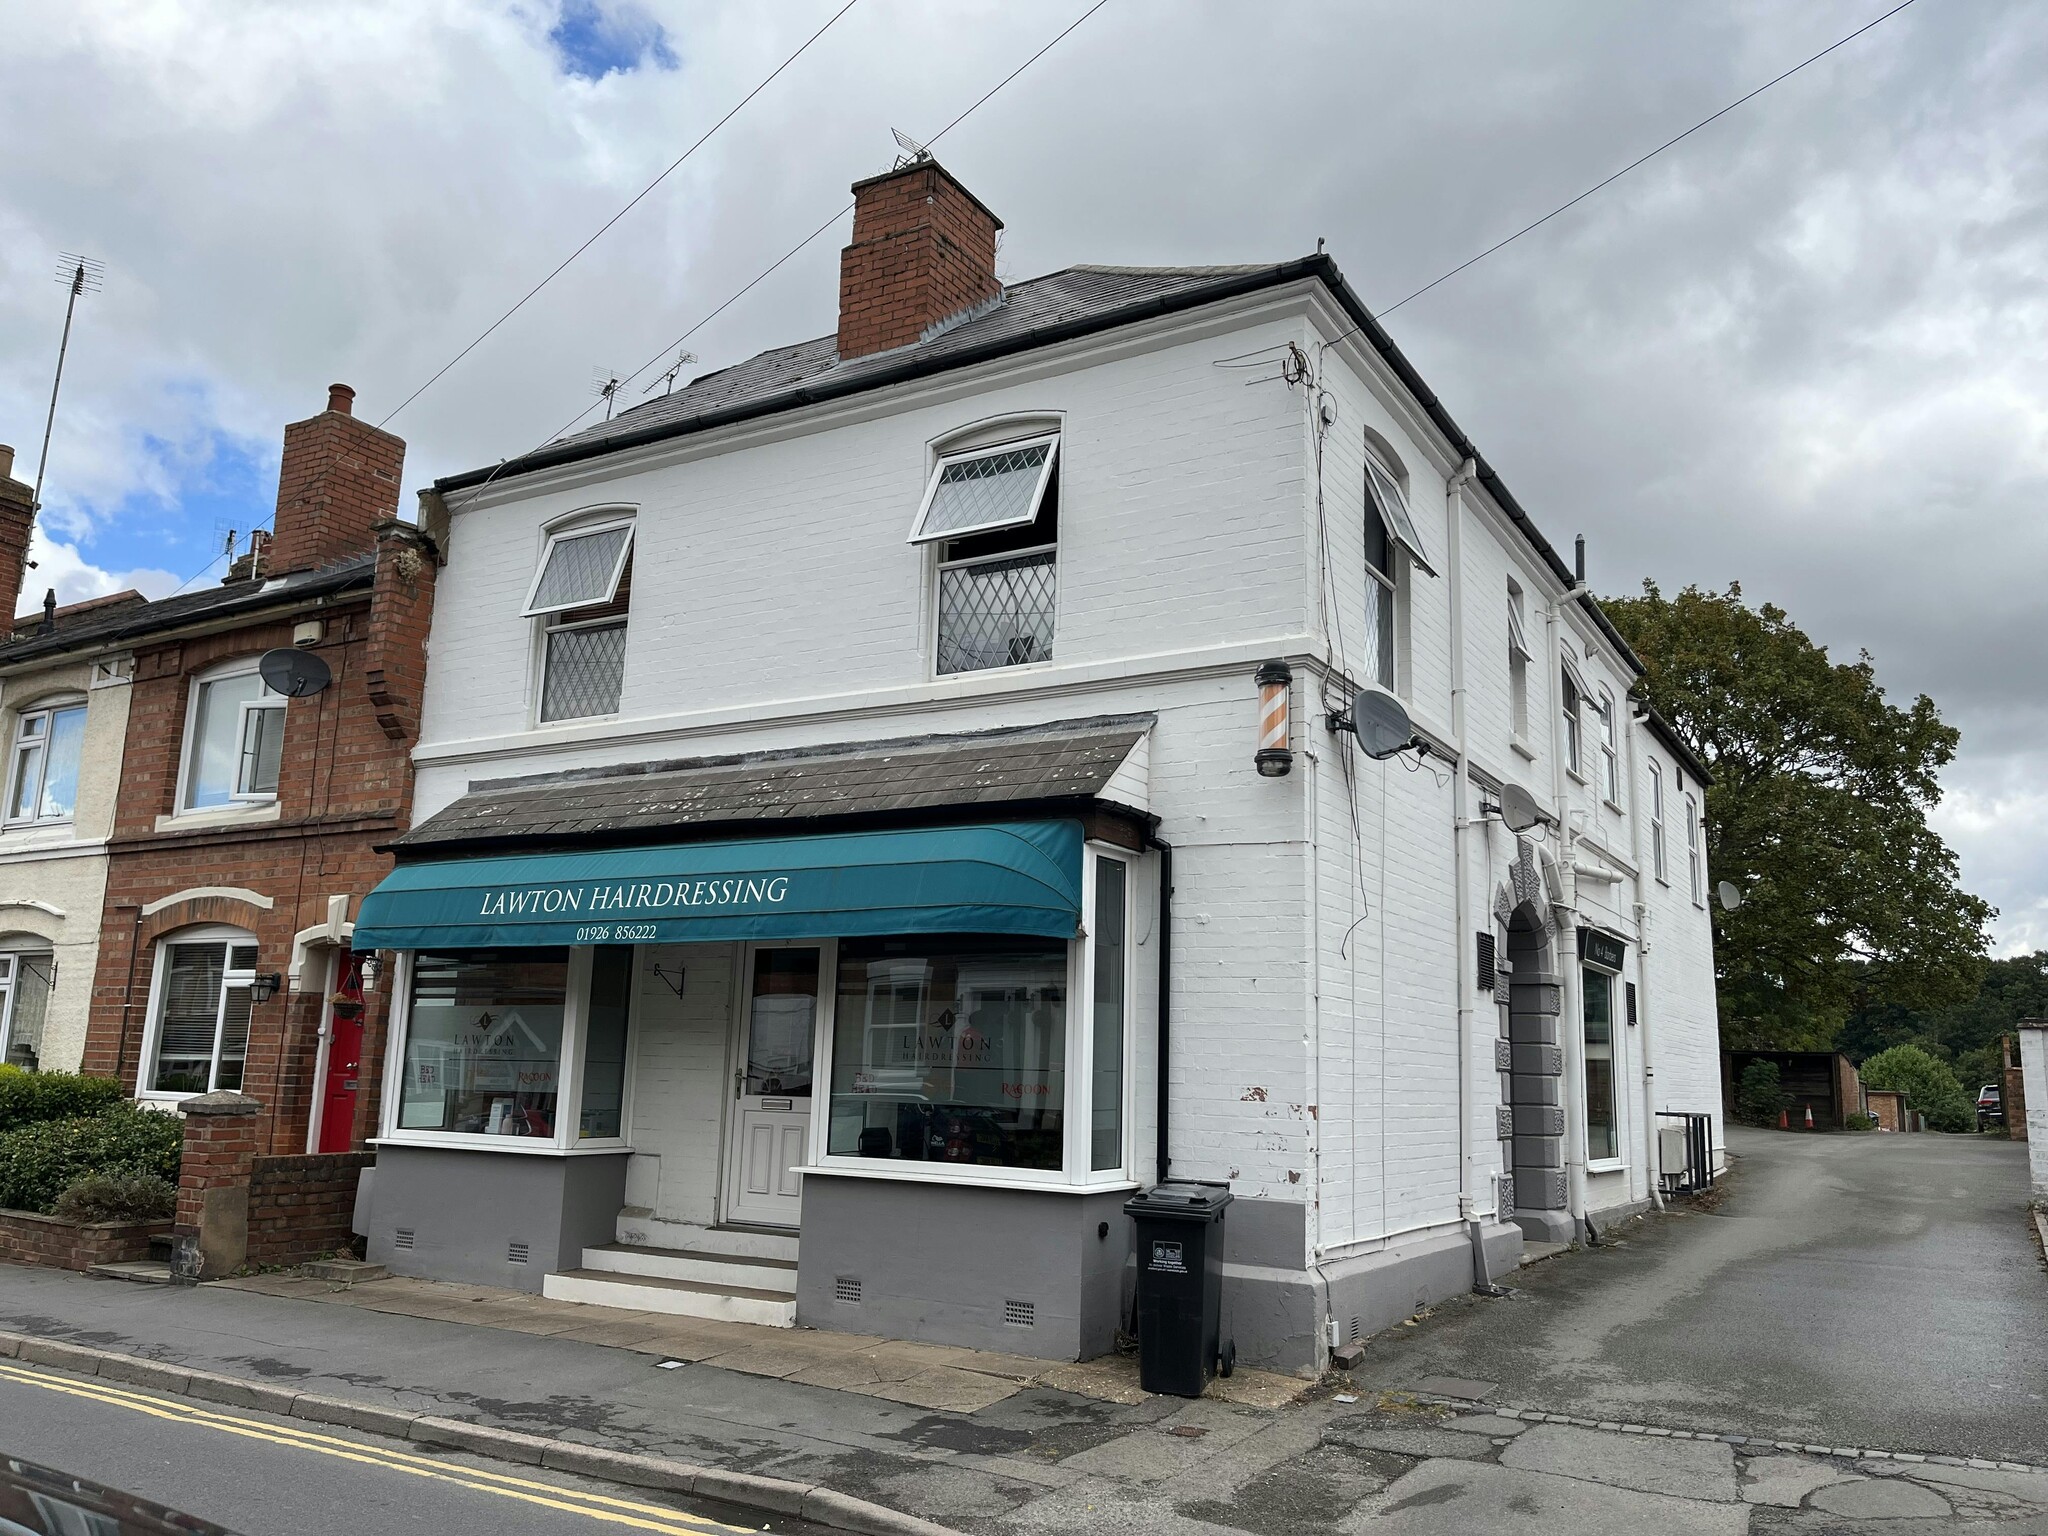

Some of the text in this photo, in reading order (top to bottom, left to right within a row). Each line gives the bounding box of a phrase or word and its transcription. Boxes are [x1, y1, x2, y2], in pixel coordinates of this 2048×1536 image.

[480, 877, 789, 915] LAWTON HAIRDRESSING
[576, 924, 657, 941] 01926 856222
[454, 1034, 514, 1047] LAWTON
[903, 1035, 992, 1051] LAWTON
[518, 1071, 552, 1085] RACOON
[1001, 1082, 1051, 1099] RACOON
